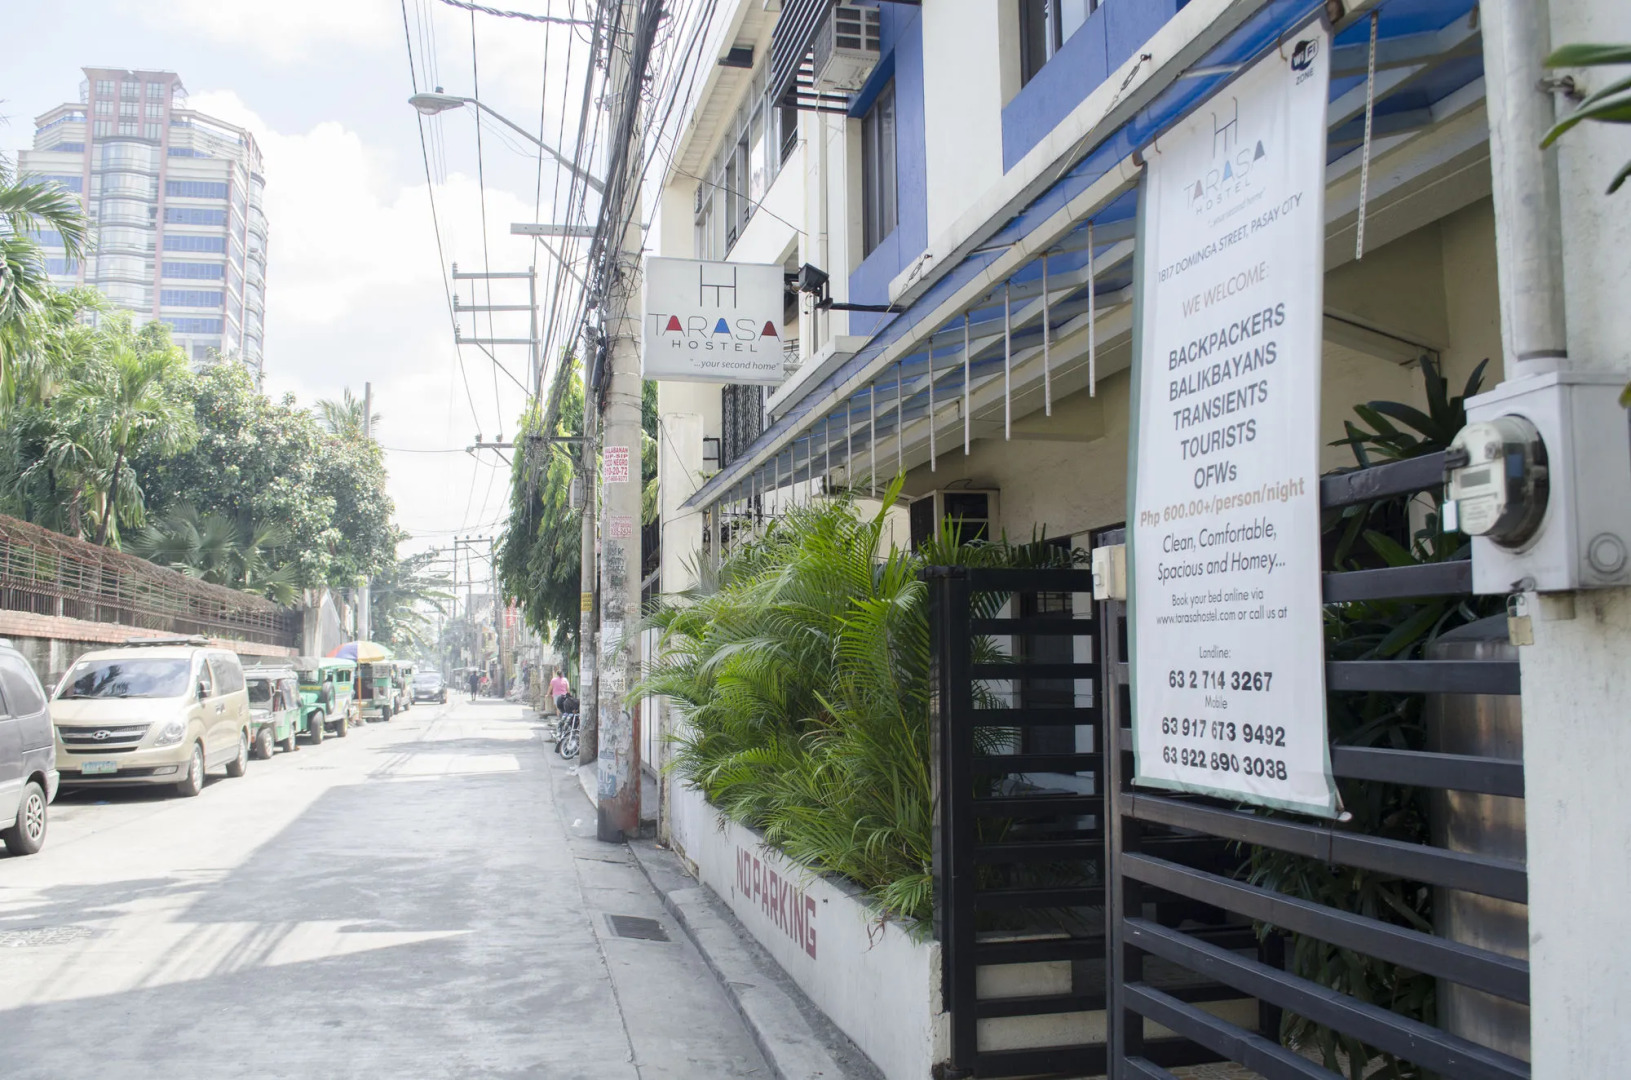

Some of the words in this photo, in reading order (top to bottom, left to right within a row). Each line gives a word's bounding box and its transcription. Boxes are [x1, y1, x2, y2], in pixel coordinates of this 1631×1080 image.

[1295, 67, 1314, 85] ZONE
[1183, 139, 1267, 209] TARASA
[1196, 178, 1251, 215] HOSTEL
[1158, 264, 1175, 283] 1817
[1175, 241, 1218, 275] DOMINGA
[1218, 224, 1249, 252] STREET,
[1250, 206, 1281, 233] PASAY
[1281, 191, 1303, 216] CITY
[1182, 294, 1201, 319] WE
[1203, 260, 1270, 309] WELCOME:
[647, 312, 781, 343] TARASA
[1168, 302, 1286, 371] BACKPACKERS
[671, 339, 758, 353] HOSTEL
[721, 360, 751, 370] second
[752, 361, 780, 371] home"
[1169, 340, 1278, 402] BALIKBAYANS
[1173, 379, 1269, 431] TRANSIENTS
[1180, 418, 1257, 460] TOURISTS
[1193, 460, 1238, 490] OFWs
[1140, 510, 1161, 527] Php
[1163, 477, 1306, 523] 600.00+/person/night
[1162, 532, 1197, 554] Clean,
[1198, 516, 1278, 548] Comfortable,
[1157, 562, 1204, 587] Spacious
[1206, 551, 1229, 574] and
[1231, 551, 1287, 575] Homey...
[1155, 607, 1237, 625] www.tarasahostel.com
[1237, 610, 1248, 621] or
[1249, 605, 1265, 621] call
[1266, 608, 1277, 620] us
[1277, 605, 1288, 619] at
[1171, 592, 1189, 607] Book
[1189, 594, 1207, 609] your
[1208, 588, 1223, 604] bed
[1223, 586, 1249, 603] online
[1250, 587, 1265, 600] via
[1198, 645, 1232, 659] Landline:
[1168, 669, 1185, 688] 63
[1189, 669, 1198, 689] 2
[1201, 670, 1226, 690] 714
[1230, 670, 1273, 692] 3267
[1204, 694, 1229, 710] Mobile
[1161, 716, 1178, 736] 63
[1181, 717, 1207, 738] 917
[1211, 720, 1237, 742] 673
[1242, 722, 1287, 748] 9492
[1162, 745, 1178, 765] 63
[1180, 747, 1208, 769] 922
[1210, 751, 1240, 773] 890
[1242, 755, 1288, 781] 3038
[736, 844, 752, 900] NO
[752, 856, 817, 961] PARKING
